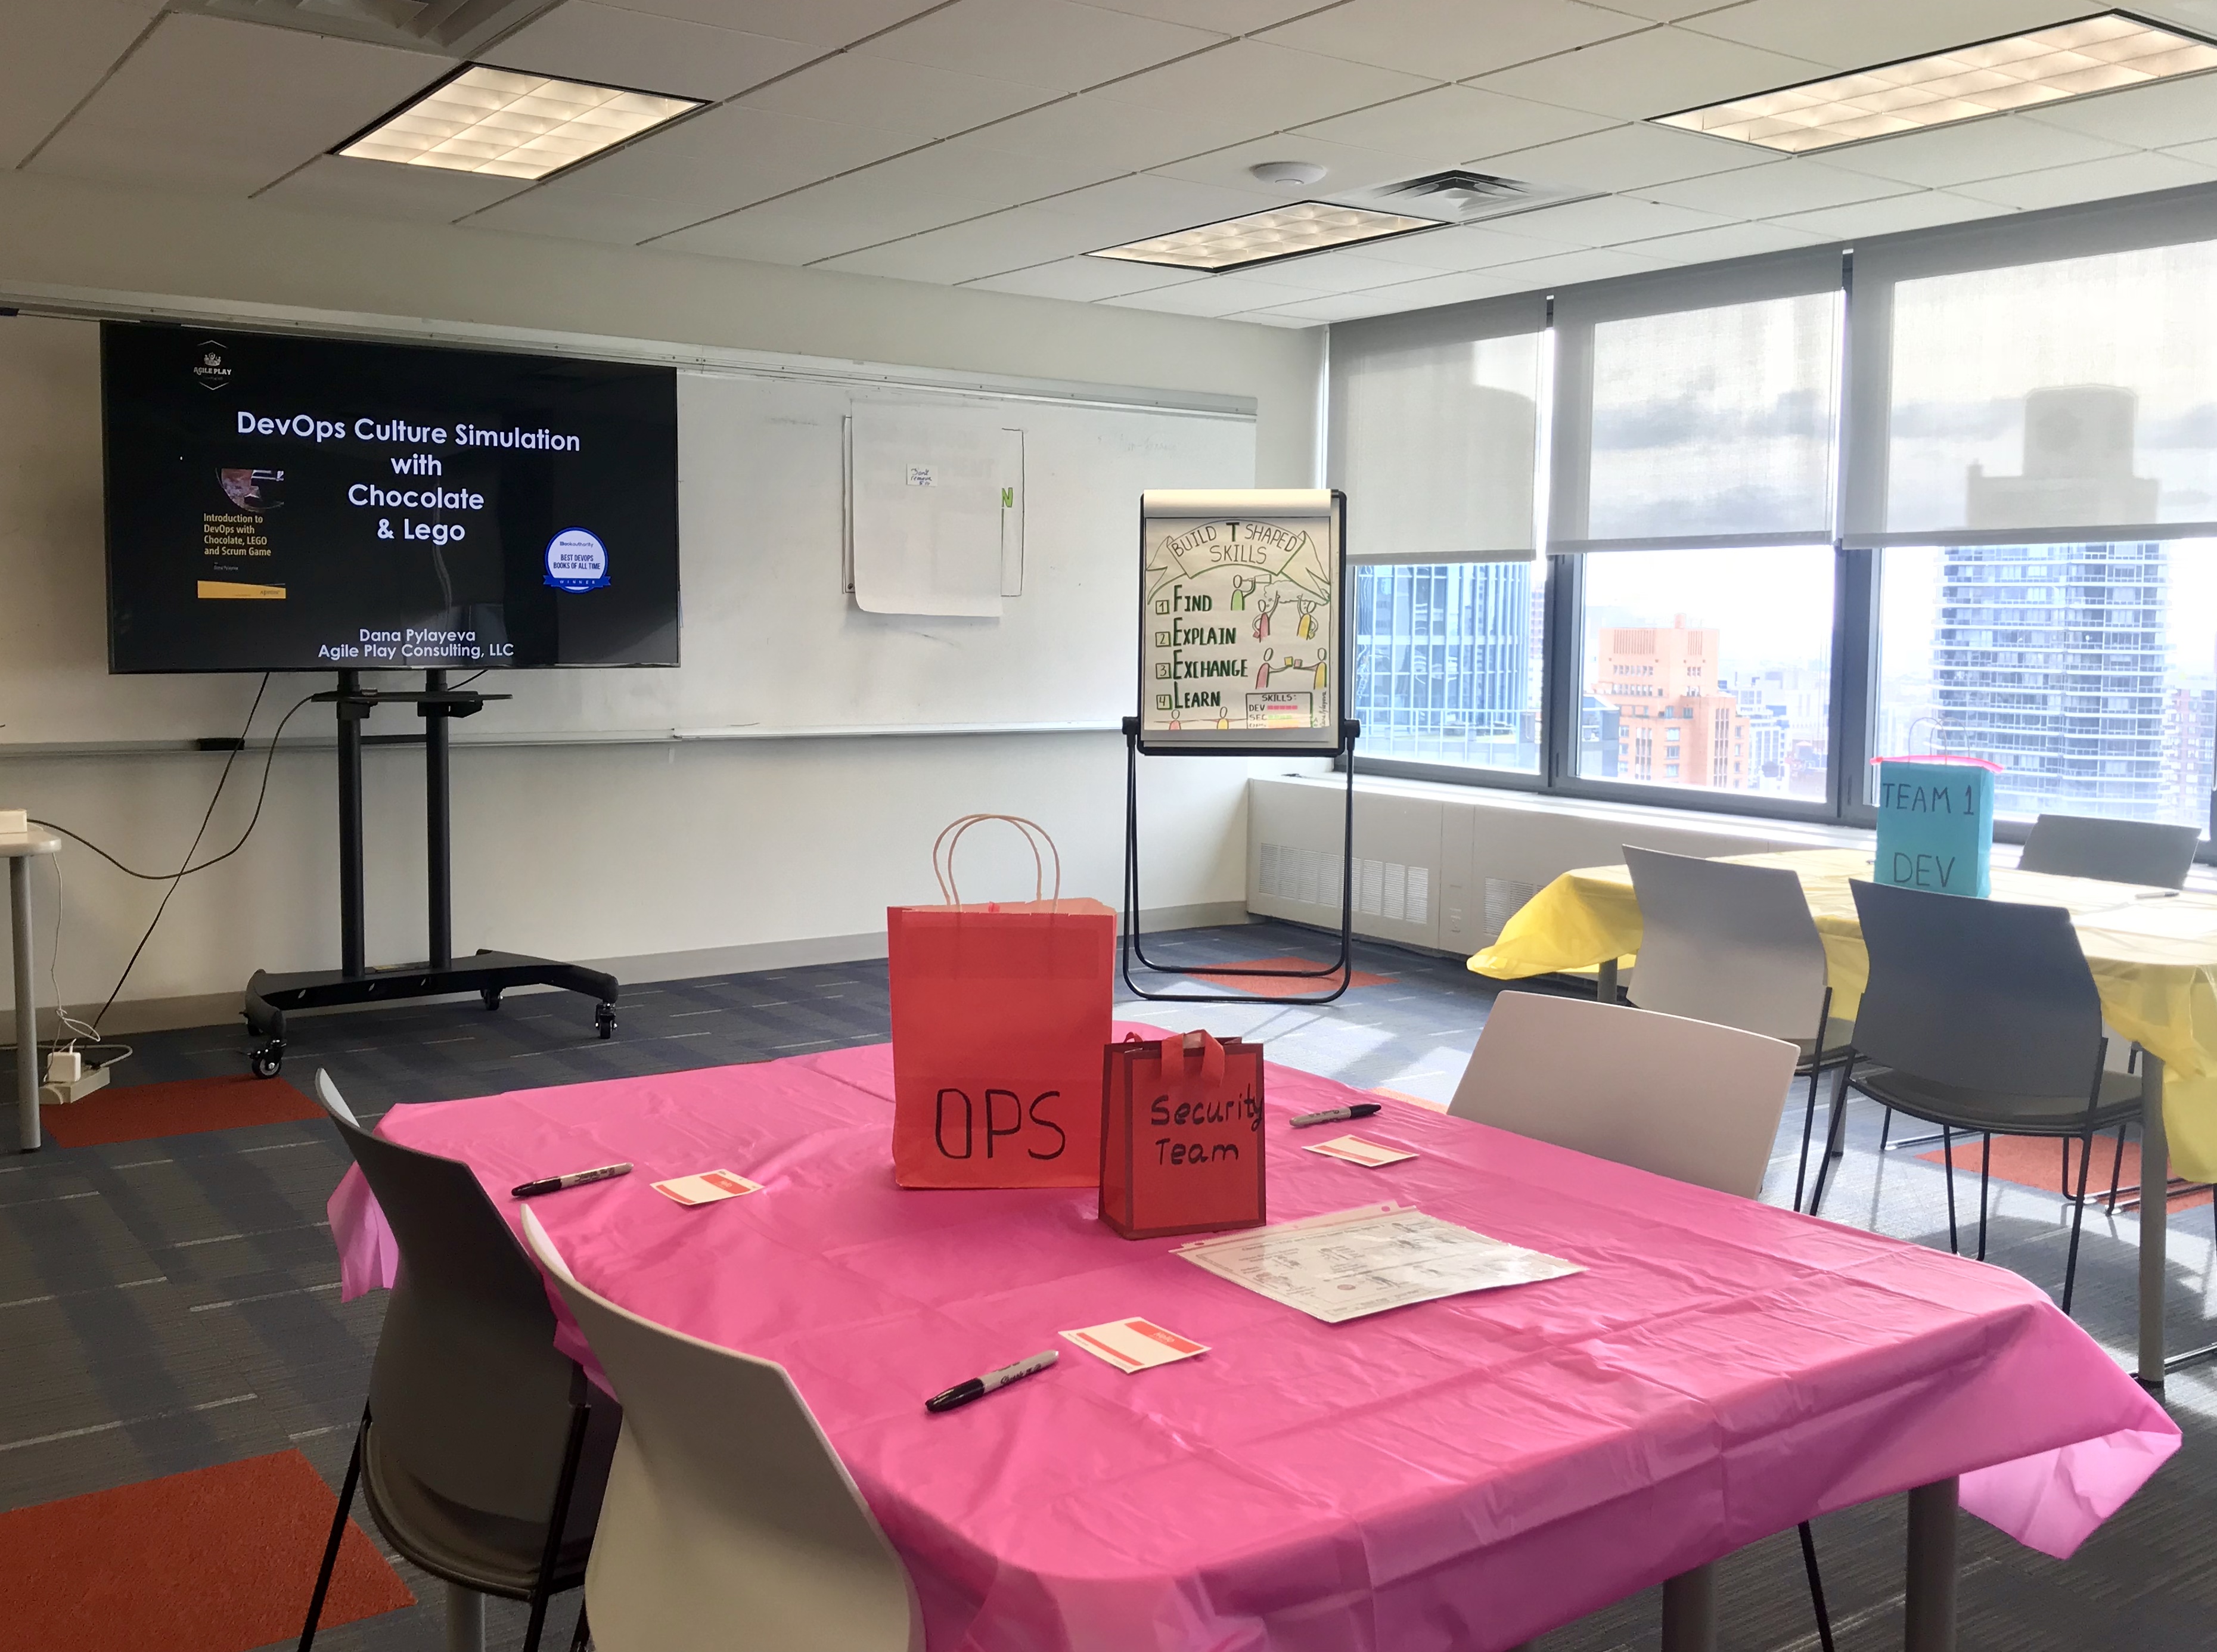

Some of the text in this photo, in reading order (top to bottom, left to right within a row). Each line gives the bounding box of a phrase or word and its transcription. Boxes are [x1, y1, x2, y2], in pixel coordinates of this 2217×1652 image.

[194, 367, 213, 375] AGILE
[238, 411, 580, 452] DevOps Culture Simulation
[390, 454, 442, 476] with
[348, 483, 485, 510] Chocolate
[204, 513, 263, 523] Introduction to
[204, 524, 255, 535] DevOps with
[377, 518, 465, 545] & Lego
[204, 535, 268, 545] Chocolate, LEGO
[204, 546, 272, 556] and Scrum Game
[1171, 522, 1298, 557] BUILD T SHAPED
[1209, 544, 1267, 564] SKILLS
[1173, 585, 1212, 612] FIND
[359, 629, 476, 644] Dana Pylayeva
[1173, 617, 1237, 647] EXPLAIN
[318, 643, 514, 661] Agile Play Consulting, LLC
[1173, 649, 1249, 680] EXCHANGE
[1174, 681, 1221, 709] LEARN
[1882, 782, 1974, 816] TEAM 1
[1893, 852, 1955, 887] DEV
[1151, 1082, 1264, 1131] Security
[935, 1088, 1066, 1160] OPS
[1155, 1137, 1239, 1166] Team
